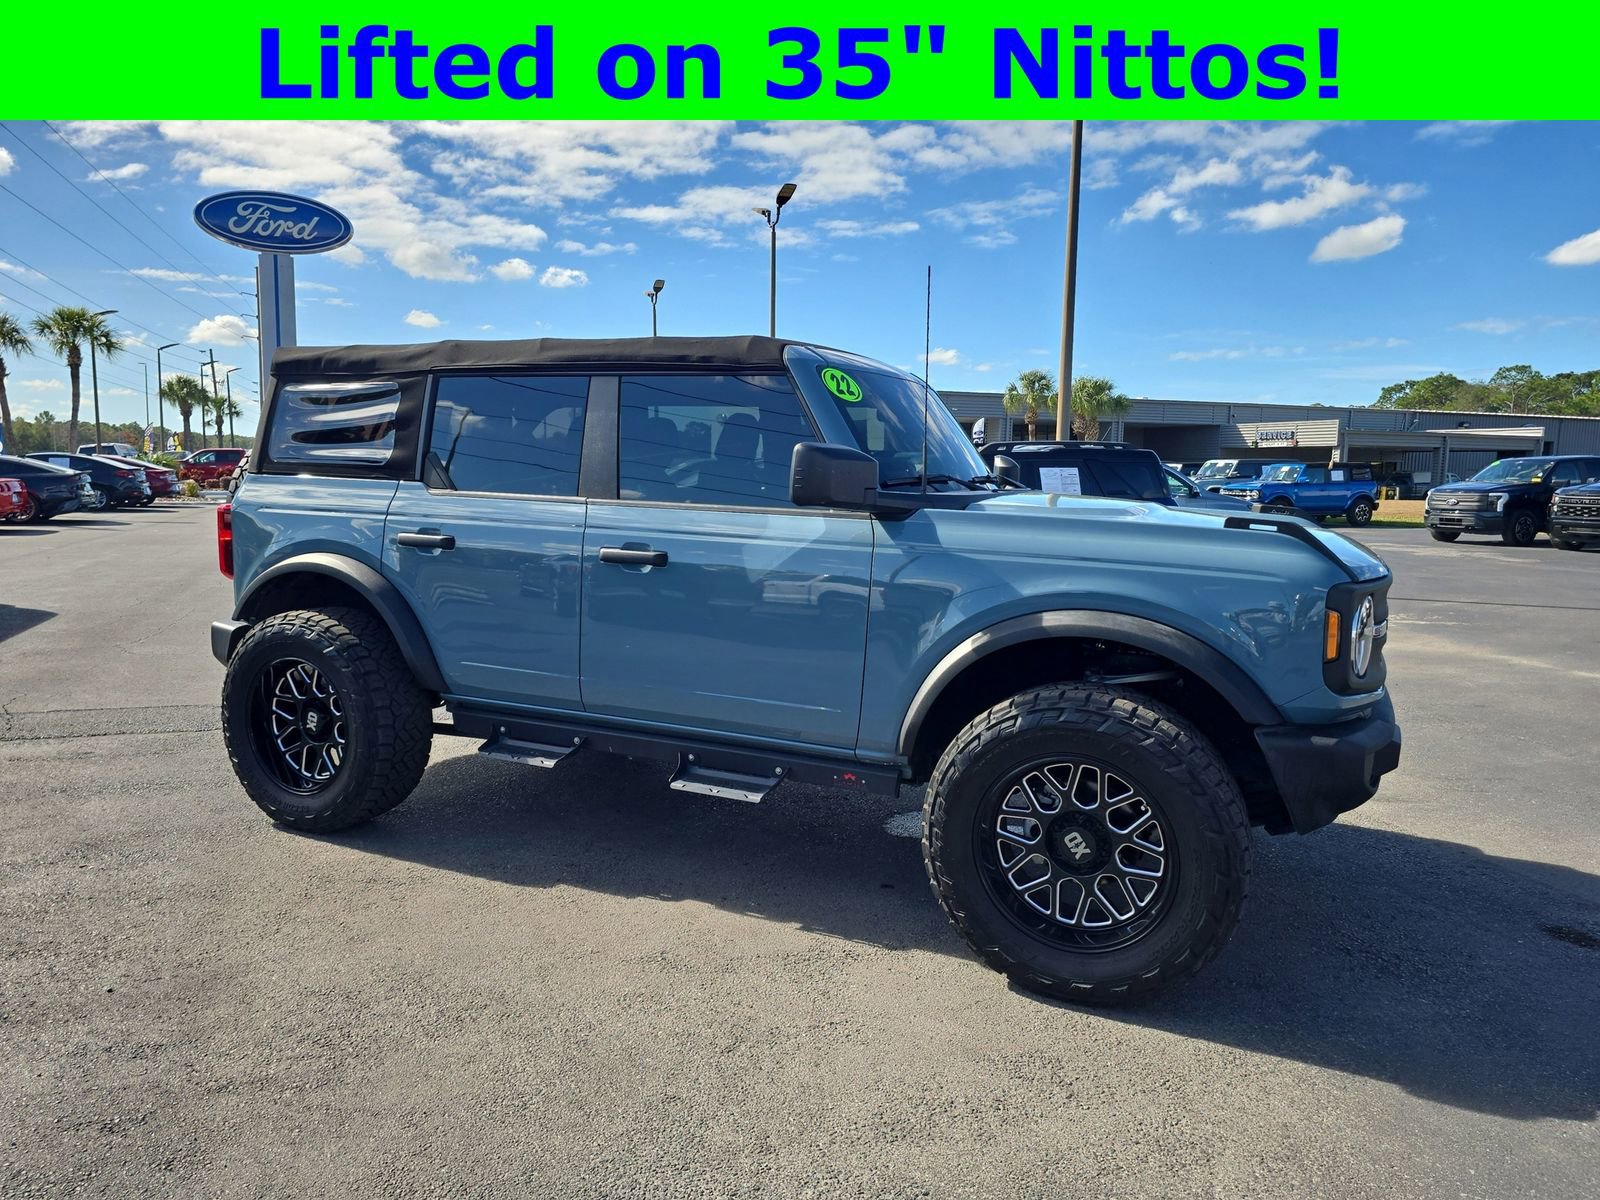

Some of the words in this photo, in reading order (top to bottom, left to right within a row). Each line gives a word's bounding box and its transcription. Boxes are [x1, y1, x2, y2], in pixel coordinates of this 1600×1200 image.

[228, 201, 320, 240] Ford
[830, 373, 856, 396] 22
[1256, 431, 1293, 440] SERVICE
